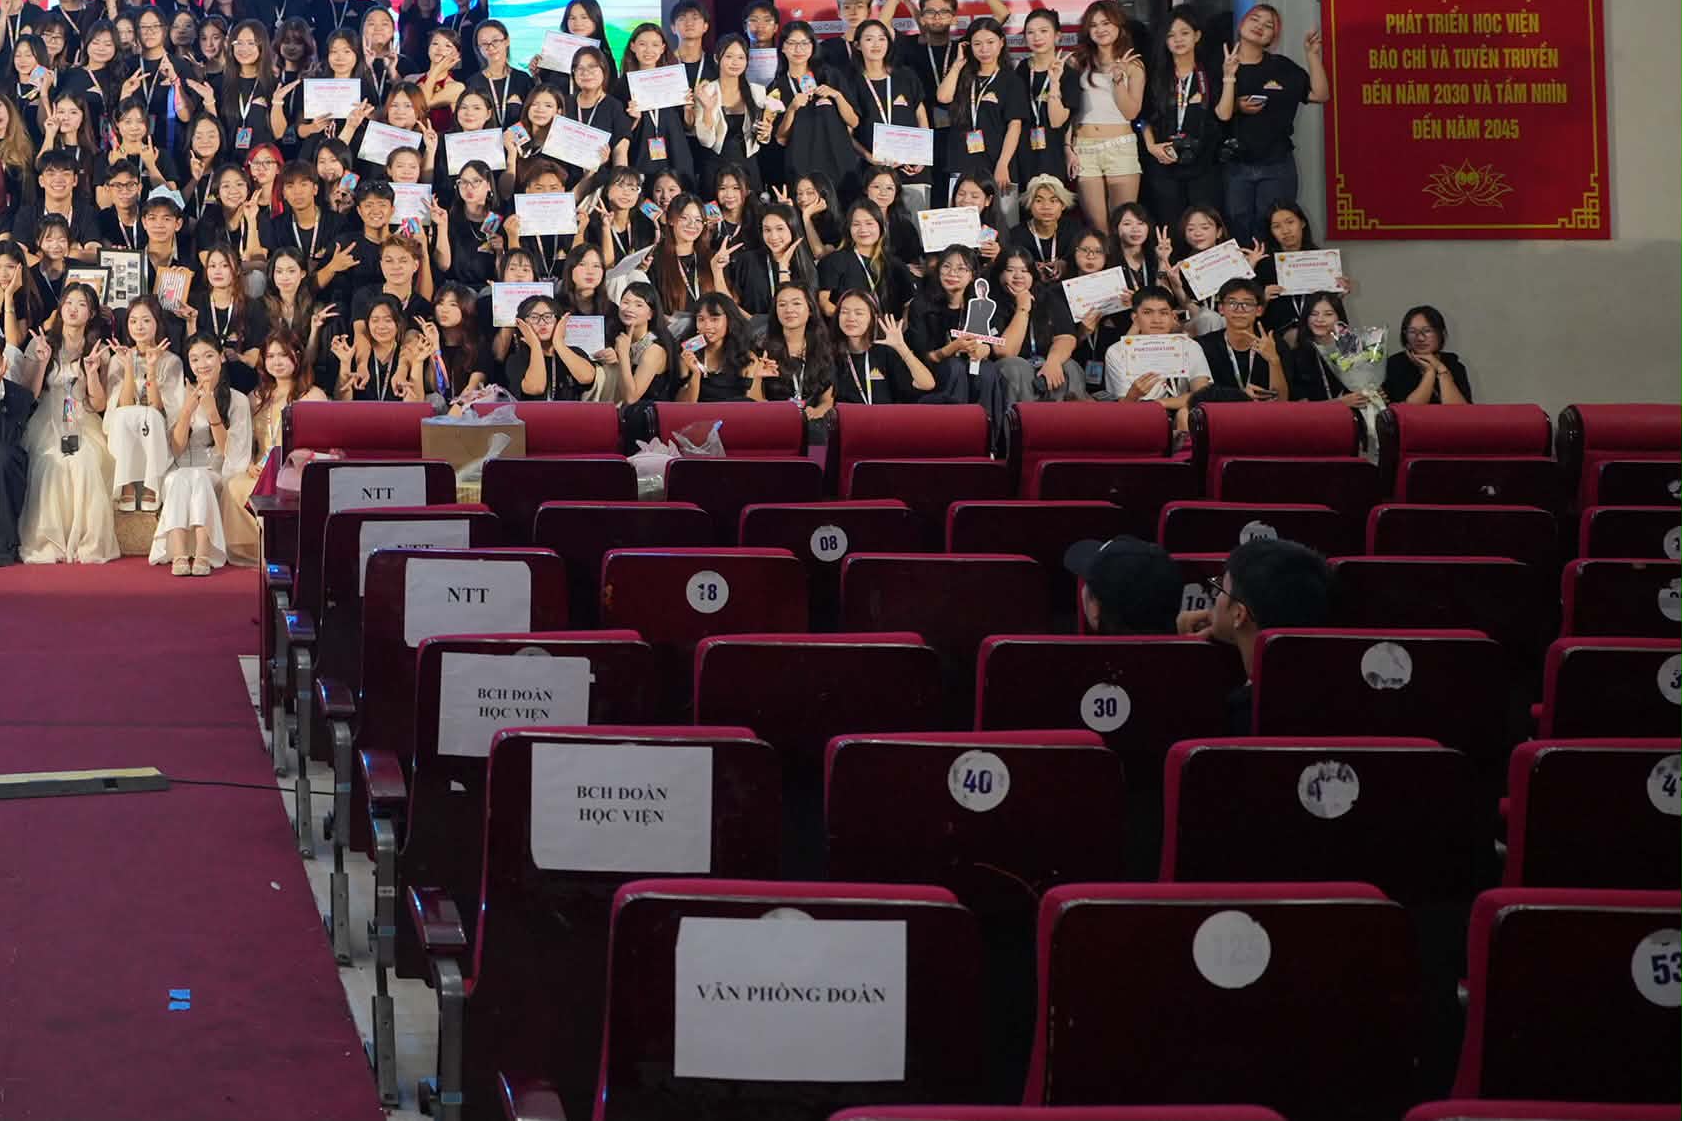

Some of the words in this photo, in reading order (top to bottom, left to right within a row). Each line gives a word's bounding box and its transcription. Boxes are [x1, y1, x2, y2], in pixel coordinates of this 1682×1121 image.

[1385, 8, 1423, 35] PHÁT
[1473, 12, 1502, 38] HỌC
[1369, 45, 1398, 70] BÁO
[1431, 43, 1450, 69] VÀ
[1454, 44, 1500, 69] TUYÊN
[1396, 79, 1431, 105] NĂM
[1433, 83, 1469, 104] 2030
[1473, 78, 1493, 104] VÀ
[1446, 114, 1481, 140] NĂM
[1484, 118, 1520, 139] 2045
[361, 487, 395, 500] NTT
[820, 535, 838, 551] 08
[447, 586, 490, 603] NTT
[697, 583, 718, 600] 18
[478, 687, 508, 701] BCH
[479, 706, 511, 720] HỌC
[517, 706, 550, 722] VIỆN
[1093, 696, 1118, 719] 30
[964, 768, 993, 795] 40
[577, 785, 612, 799] BCH
[580, 807, 618, 825] HỌC
[623, 808, 664, 826] VIỆN
[696, 982, 740, 1001] VĂN
[747, 982, 821, 1003] PHÒNG
